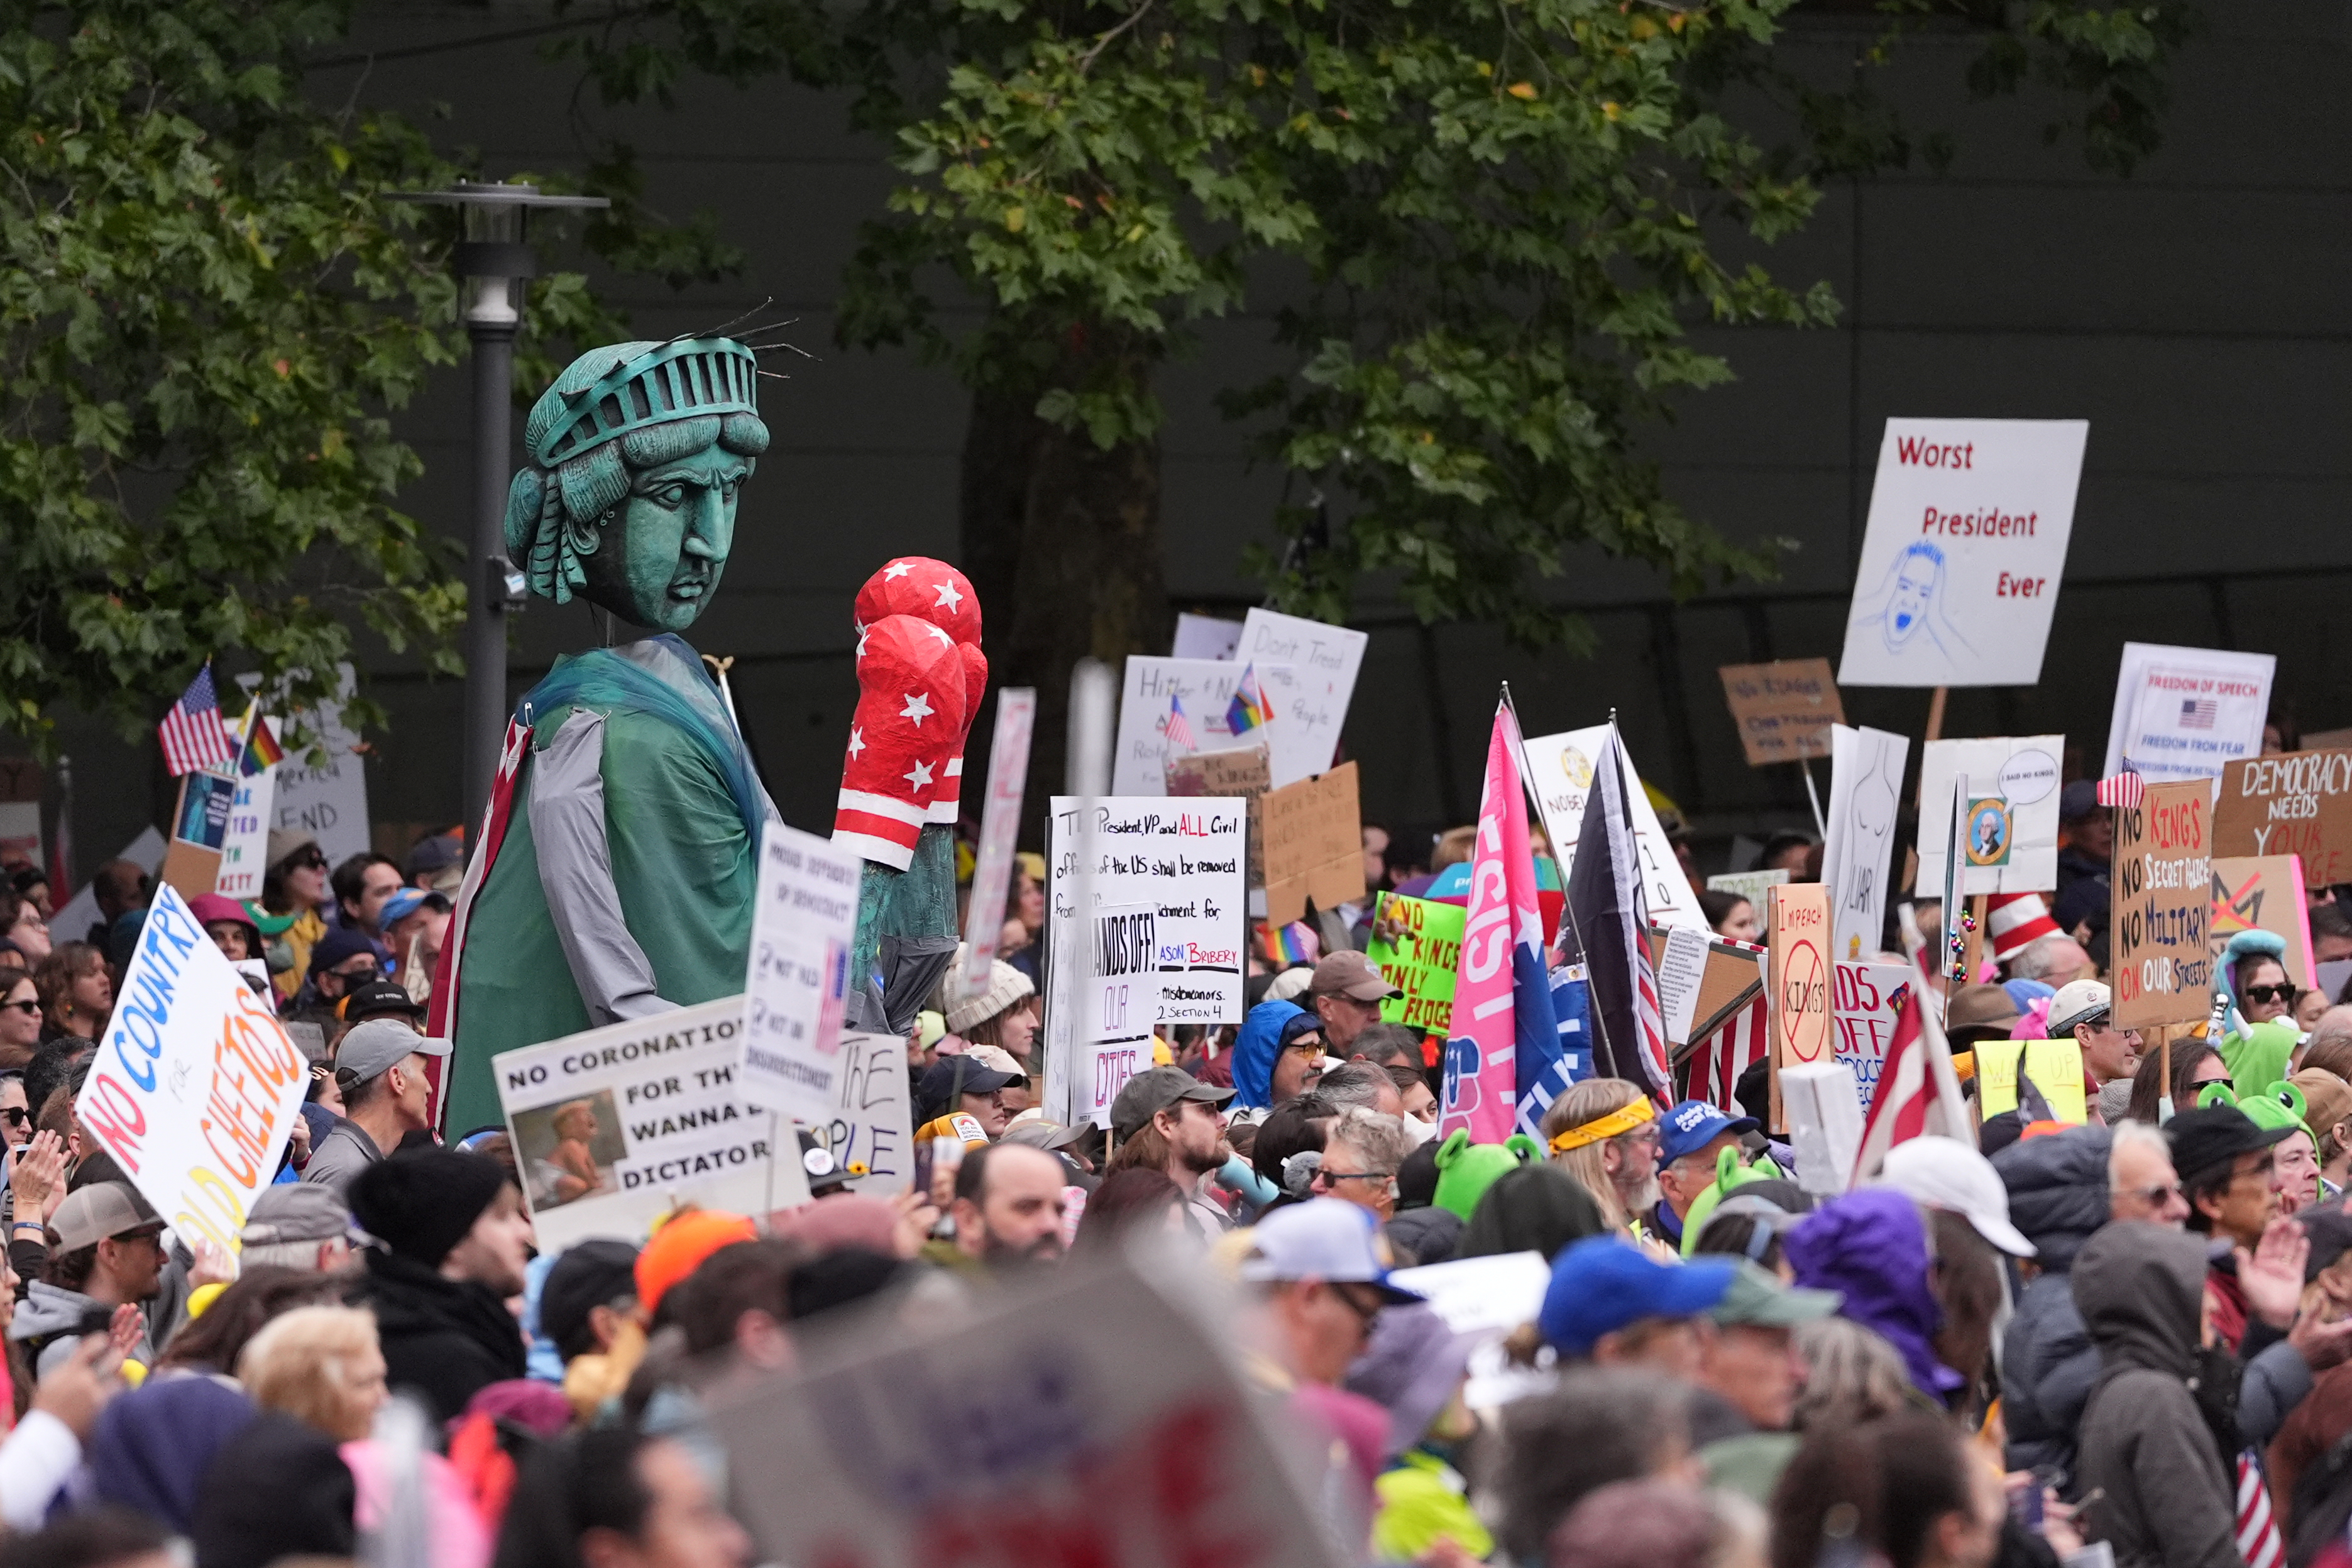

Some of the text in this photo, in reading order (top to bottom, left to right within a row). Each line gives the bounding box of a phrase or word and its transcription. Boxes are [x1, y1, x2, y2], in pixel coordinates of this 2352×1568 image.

[1897, 436, 1974, 470] Worst
[1921, 507, 2038, 537] President
[1996, 571, 2045, 598] Ever
[2148, 674, 2258, 697] FREEDOM OF SPEECH
[2141, 734, 2245, 755] FREEDOM FROM FEAR
[2241, 753, 2352, 799] DEMOCRACY
[279, 803, 338, 831] END
[2123, 793, 2201, 849] NO KINGS
[2268, 794, 2319, 821] NEEDS
[1144, 814, 1160, 835] VP
[1159, 821, 1177, 835] and
[1179, 813, 1209, 837] ALL
[1211, 815, 1238, 835] Civil
[2254, 822, 2321, 857] YOUR
[1113, 857, 1129, 875] the
[1131, 854, 1148, 875] US
[1151, 859, 1177, 878] shall
[1180, 853, 1195, 875] be
[1197, 858, 1236, 875] removed
[2122, 857, 2142, 902] NO
[2144, 852, 2185, 891] SECRET
[1400, 901, 1424, 931] NO
[1779, 899, 1822, 931] IMPEACH
[2121, 894, 2207, 959] NO MILITARY
[1092, 912, 1155, 978] ANDS OFF!
[1160, 942, 1238, 967] ASON, BRIBERY,
[1412, 935, 1461, 974] KINGS
[1381, 964, 1428, 997] ONLY
[2121, 956, 2207, 1002] ON OUR STREETS
[1104, 984, 1129, 1031] OUR
[1157, 1005, 1221, 1020] 2 SECTION 4
[1402, 996, 1453, 1031] FROGS
[1785, 980, 1824, 1014] KINGS
[84, 884, 201, 1176] NO COUNTRY
[1833, 1016, 1889, 1056] OFF
[508, 1066, 547, 1090] NO
[626, 1063, 739, 1105] FOR TH
[1984, 1053, 2074, 1084] WAE UP
[200, 987, 300, 1189] CHEETOS
[631, 1103, 739, 1143] WANNA
[623, 1140, 771, 1189] DICTATOR
